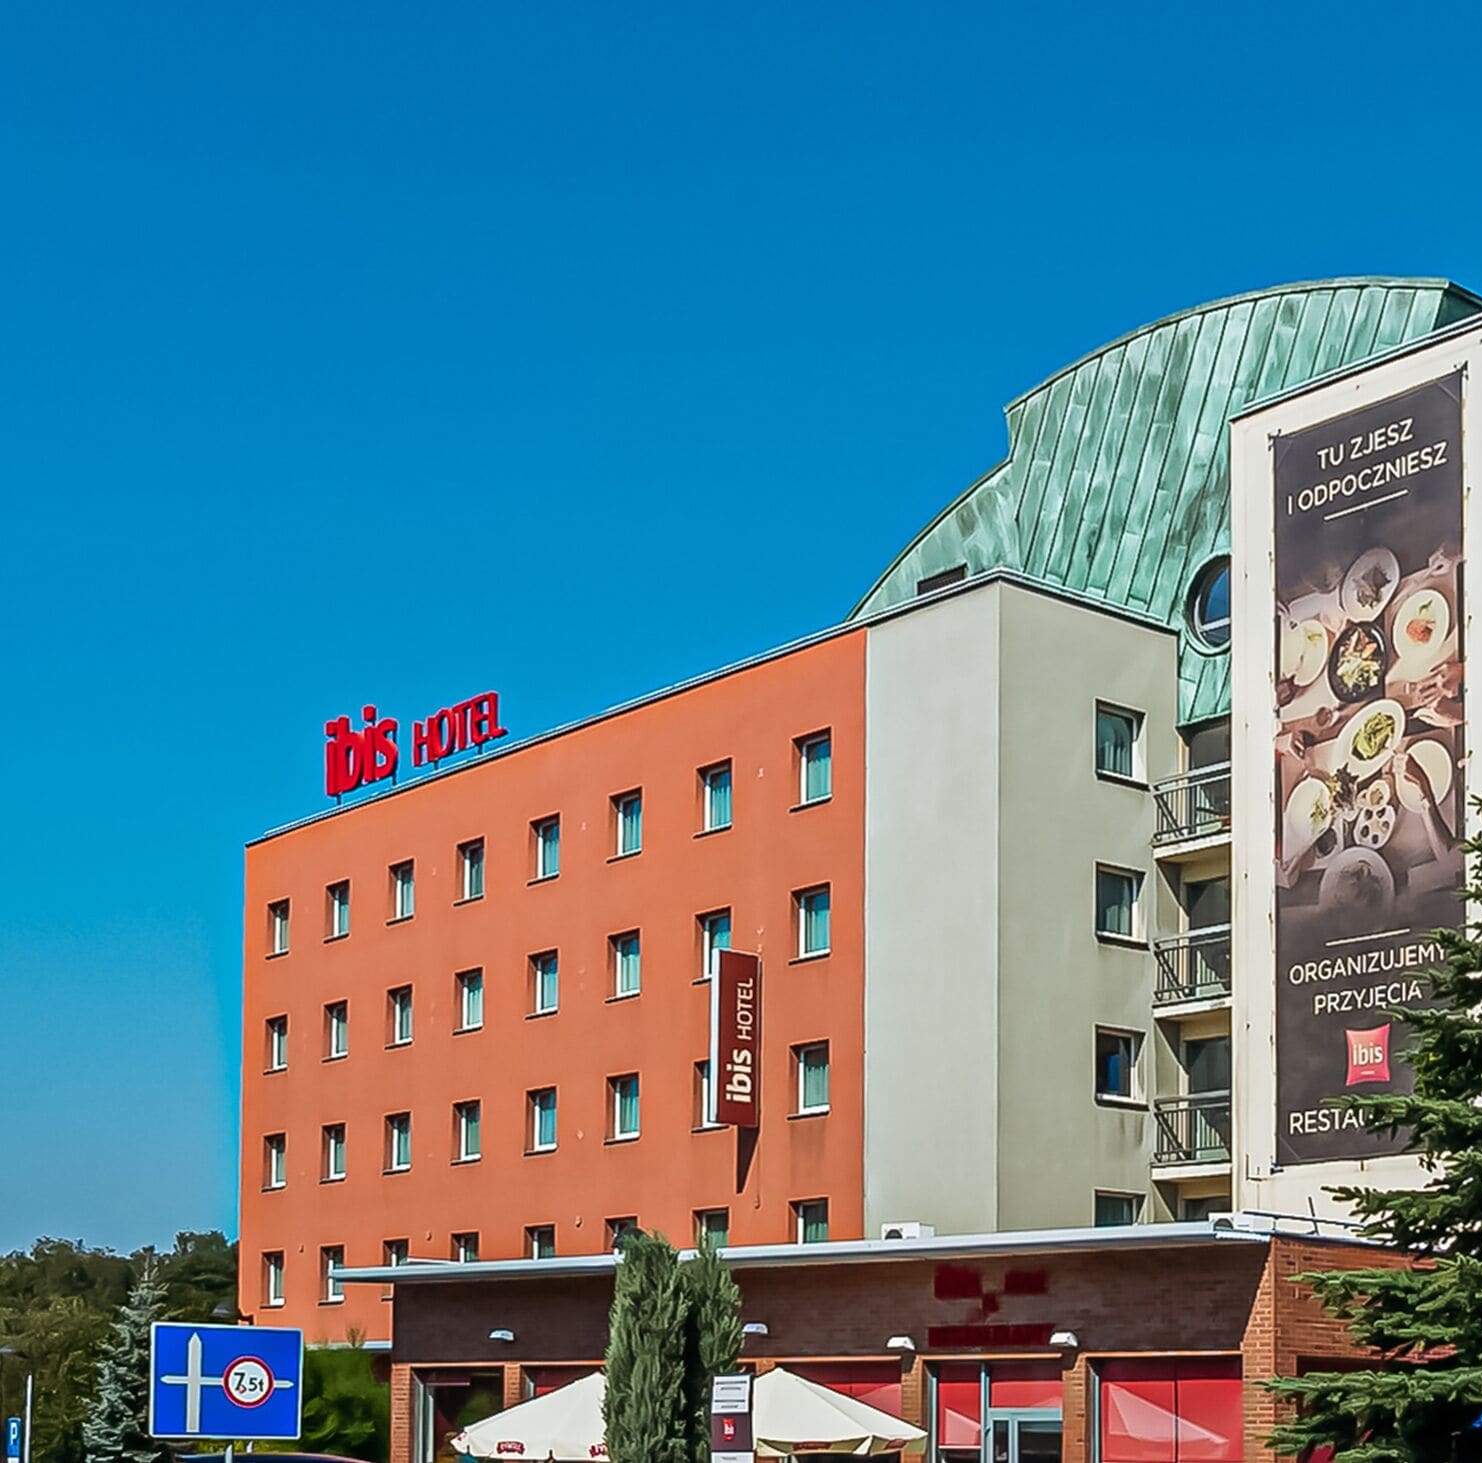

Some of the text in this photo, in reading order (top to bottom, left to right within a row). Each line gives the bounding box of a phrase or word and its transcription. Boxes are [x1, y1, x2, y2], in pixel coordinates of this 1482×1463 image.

[1317, 418, 1413, 470] TU ZJESZ
[1287, 441, 1448, 515] I ODPOCZNIESZ
[326, 692, 508, 795] ibis HOTEL
[1289, 943, 1445, 985] ORGANIZUJEMY
[1314, 980, 1423, 1015] PRZYJĘCIA
[725, 978, 754, 1103] ibis HOTEL
[1353, 1041, 1383, 1066] ibis
